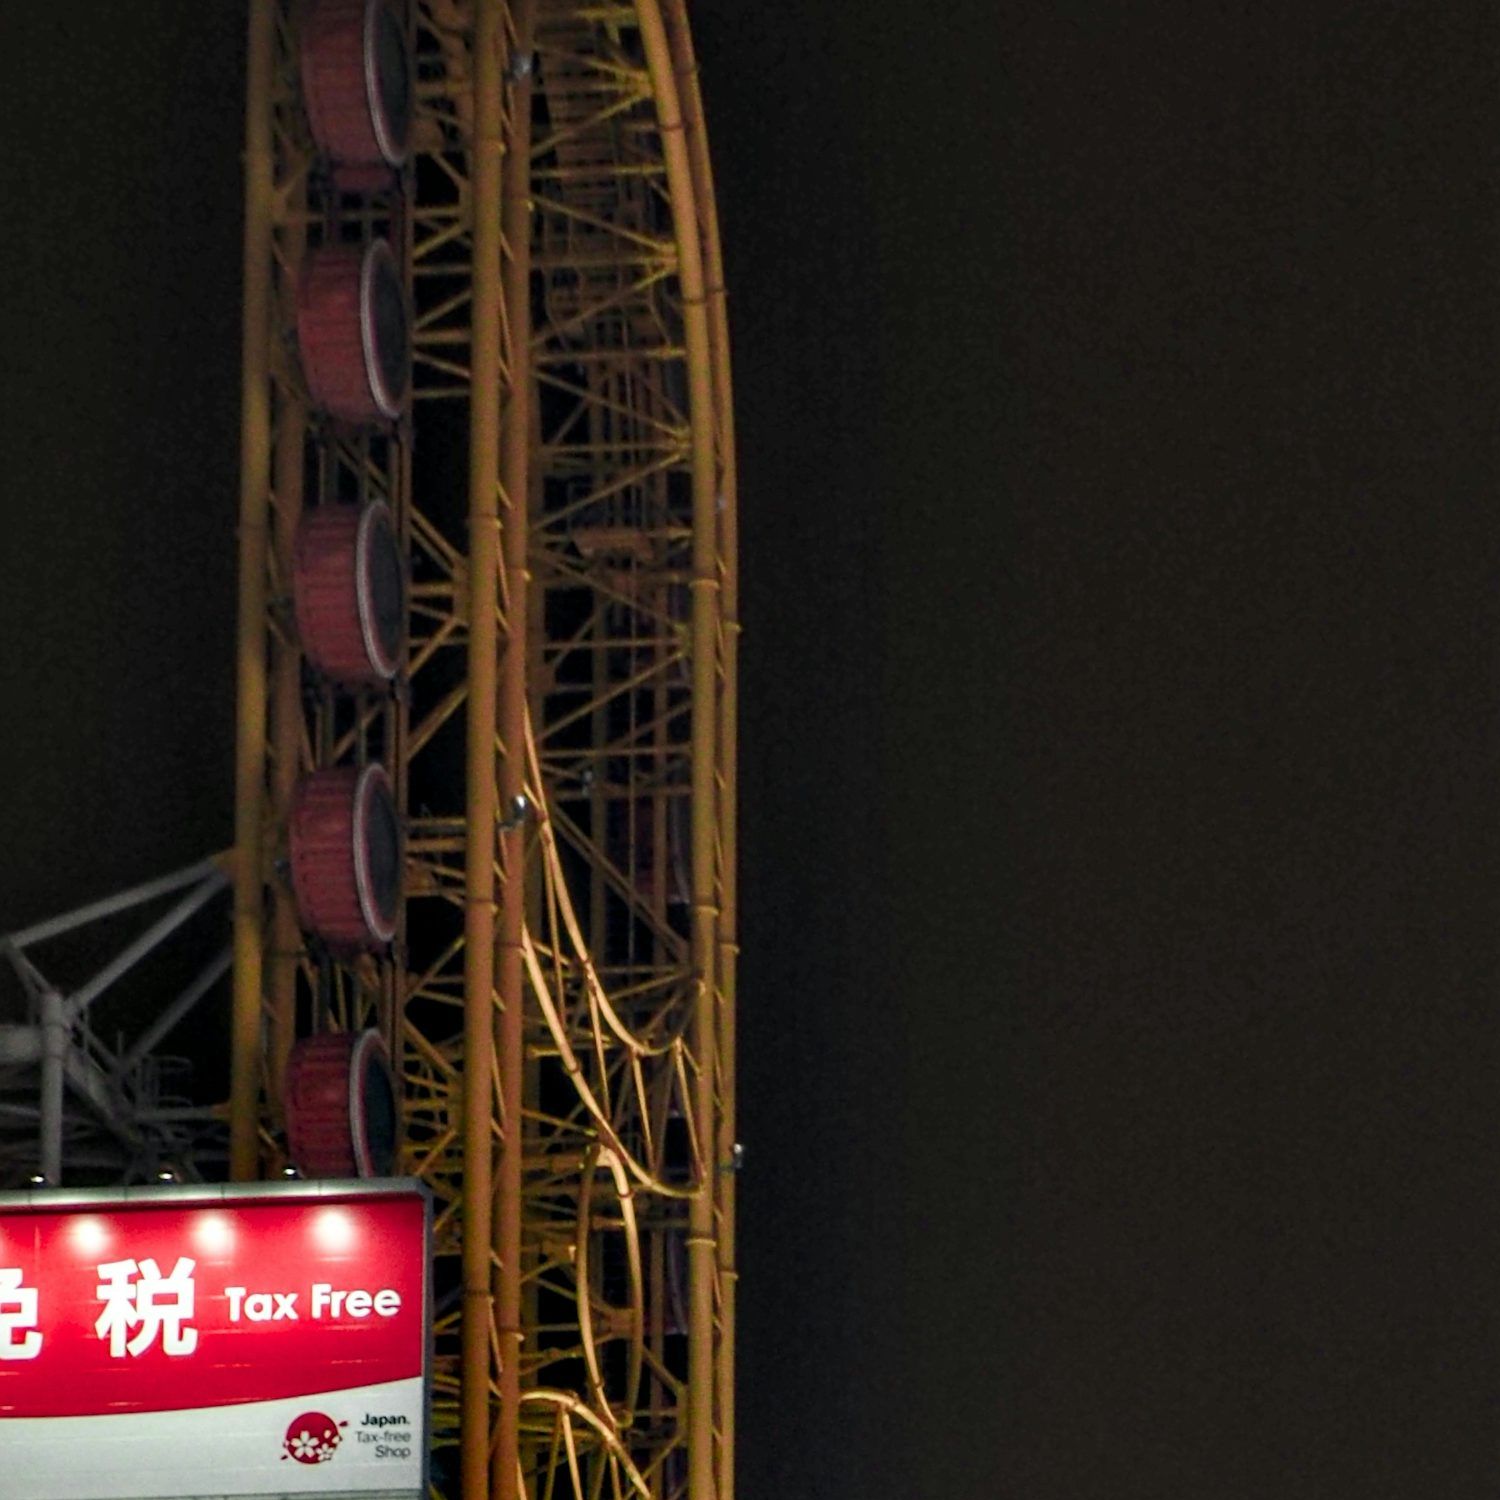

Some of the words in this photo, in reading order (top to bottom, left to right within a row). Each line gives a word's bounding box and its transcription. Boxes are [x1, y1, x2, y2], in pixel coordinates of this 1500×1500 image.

[225, 1286, 298, 1324] Tax
[311, 1282, 401, 1320] Free
[360, 1412, 411, 1430] Japan.
[355, 1430, 412, 1446] Tax-free
[374, 1444, 412, 1463] Shop
